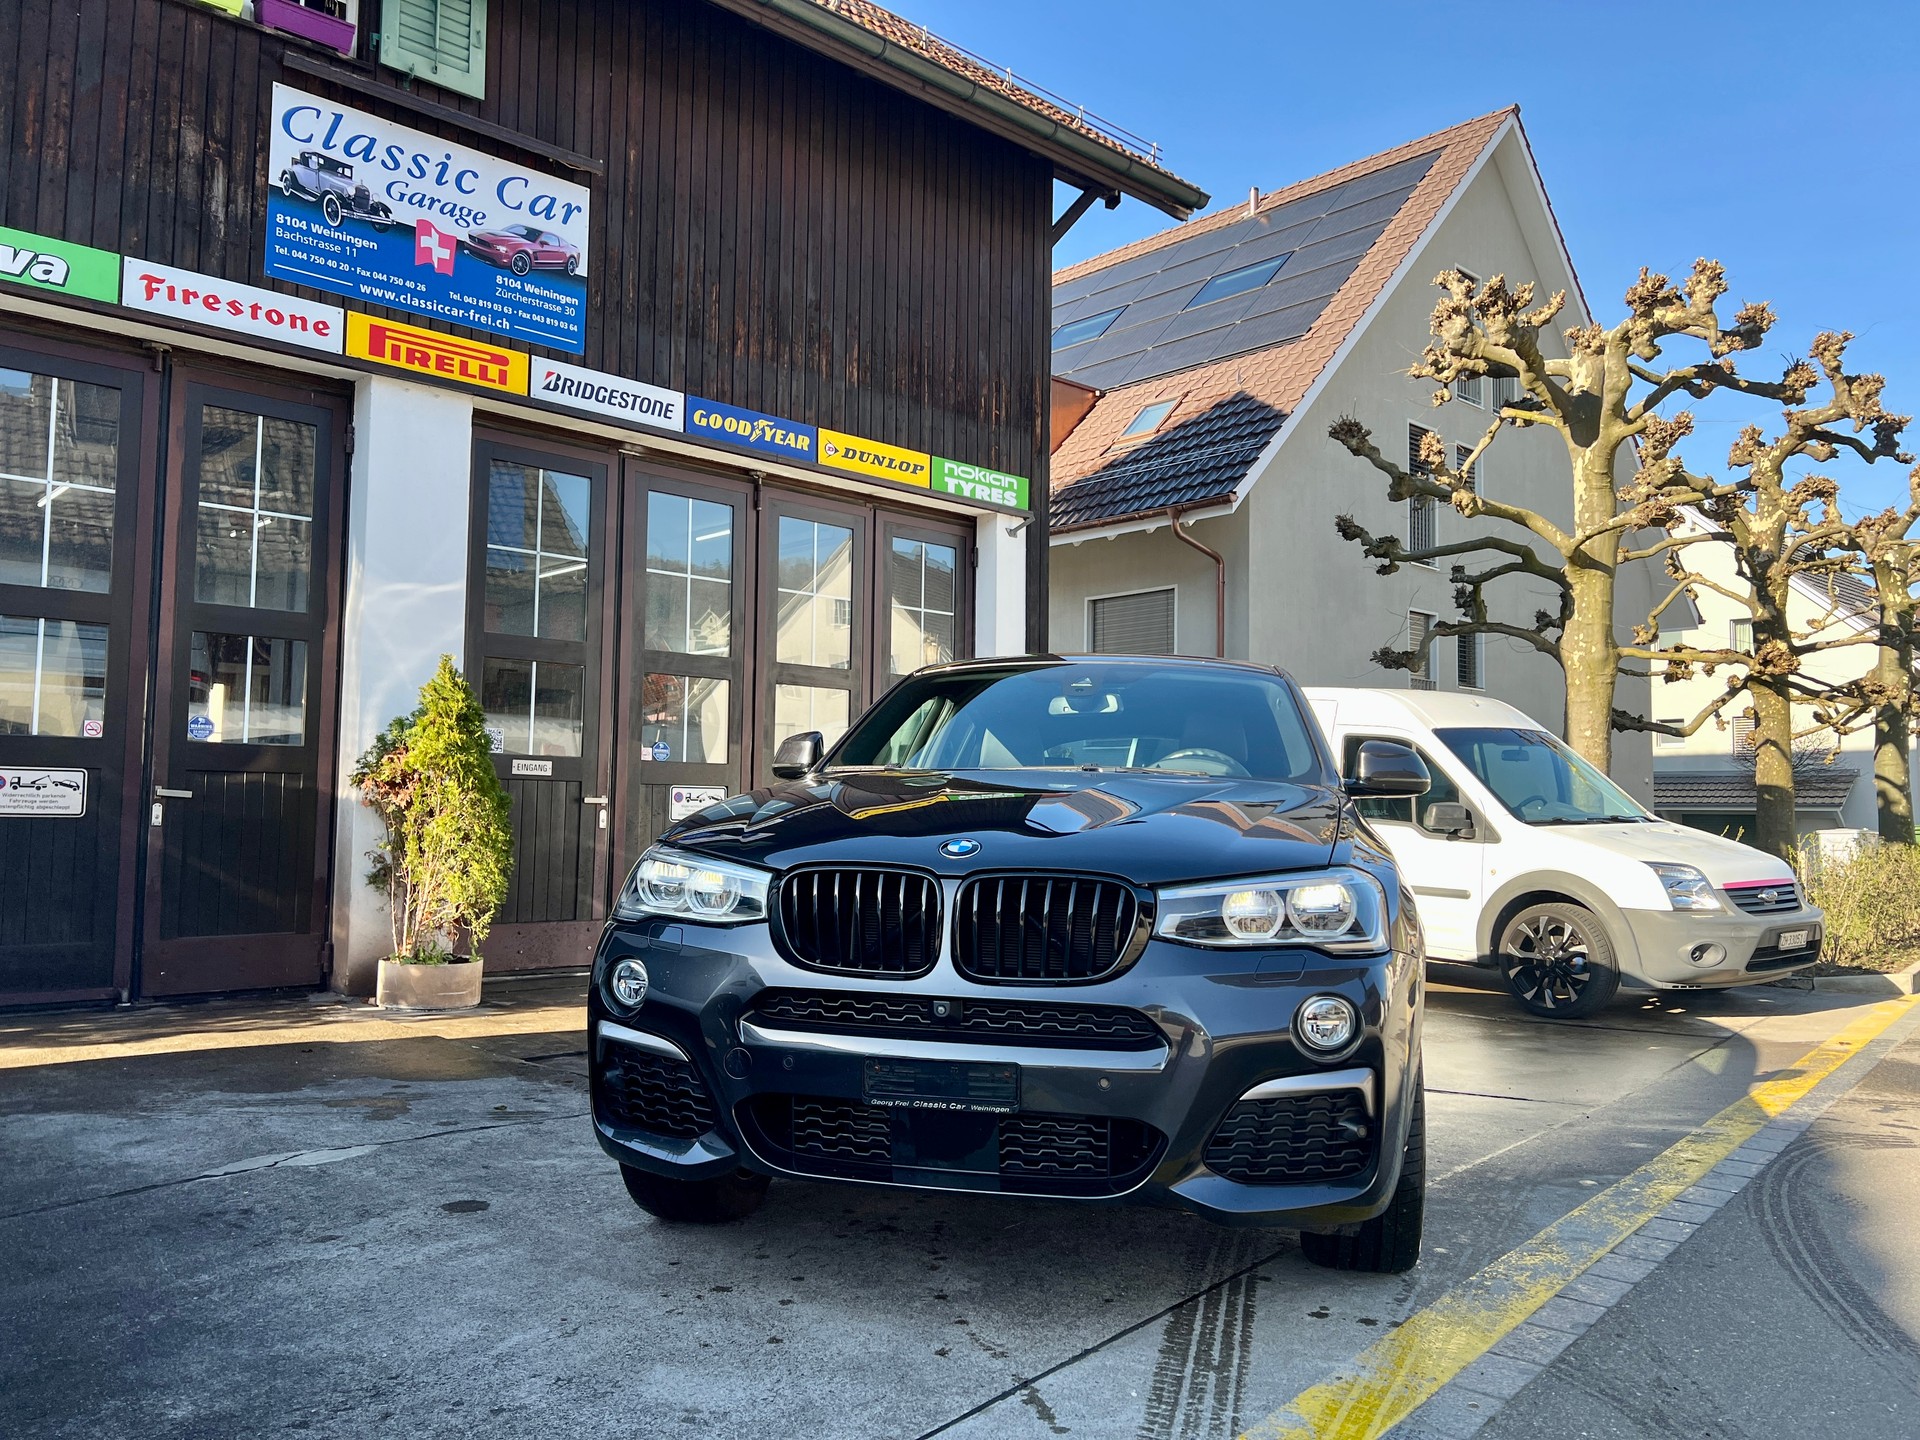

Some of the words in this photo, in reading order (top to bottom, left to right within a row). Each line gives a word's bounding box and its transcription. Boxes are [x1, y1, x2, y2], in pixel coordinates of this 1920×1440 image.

[281, 105, 480, 195] Classic
[495, 176, 582, 225] Car
[385, 180, 487, 228] Garage
[275, 213, 308, 231] 8104
[310, 222, 378, 250] Weiningen
[275, 227, 342, 254] Bachstrasse
[345, 247, 357, 257] 11
[274, 245, 290, 256] Tel.
[292, 249, 307, 260] 044
[310, 254, 325, 265] 750
[326, 259, 338, 268] 40
[339, 261, 350, 271] 20
[356, 266, 371, 278] Fax
[372, 271, 387, 282] 044
[389, 275, 404, 286] 750
[404, 279, 415, 289] 40
[416, 282, 427, 292] 26
[138, 273, 331, 337] Firestone
[359, 282, 510, 331] www.classiccar-frei.ch
[495, 275, 522, 290] 8104
[524, 282, 578, 306] Weiningen
[495, 287, 562, 313] Zürcherstrasse
[564, 305, 575, 317] 30
[449, 291, 463, 302] Tel.
[463, 295, 477, 305] 043
[478, 299, 492, 309] 819
[493, 303, 502, 312] 03
[503, 306, 512, 315] 63
[518, 309, 531, 320] Fax
[532, 314, 545, 323] 043
[546, 317, 558, 327] 819
[559, 321, 568, 330] 03
[569, 323, 578, 332] 64
[368, 324, 510, 387] PIRELLI
[541, 370, 675, 420] BRIDGESTONE
[841, 447, 925, 475] DUNLOP
[944, 477, 1018, 507] TYRES
[516, 763, 548, 772] EINGANG
[871, 1098, 893, 1107] Georg
[913, 1101, 947, 1110] Classic
[949, 1102, 966, 1110] Car
[970, 1104, 1010, 1113] Weiningen
